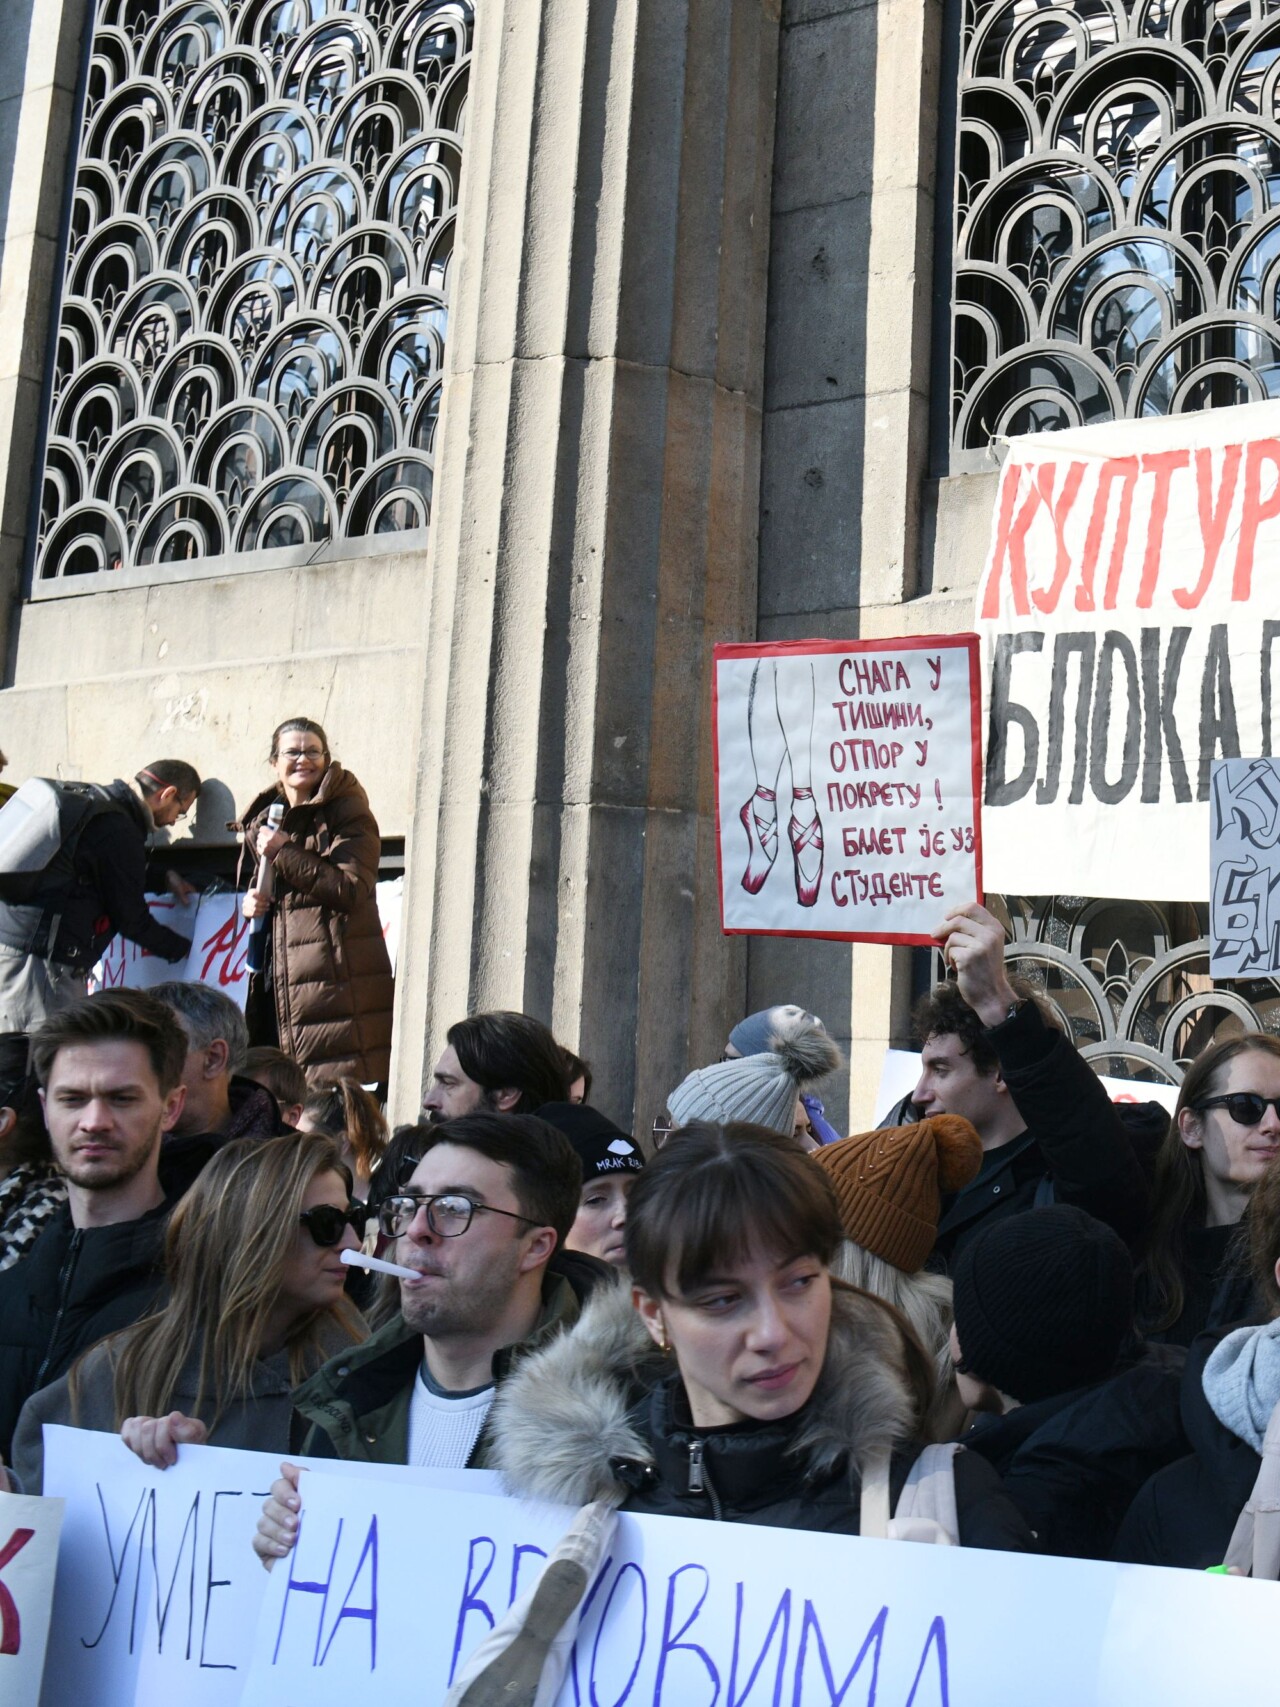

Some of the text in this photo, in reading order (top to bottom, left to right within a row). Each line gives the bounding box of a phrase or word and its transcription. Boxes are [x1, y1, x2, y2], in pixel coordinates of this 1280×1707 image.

[839, 655, 942, 696] СНАГА У
[832, 700, 934, 732] ТИШИНИ,
[829, 739, 928, 772] ОТПОР У
[841, 826, 907, 857] БАЛЕТ
[950, 827, 975, 854] УЗ
[831, 869, 945, 907] СТУДЕНТЕ
[596, 1156, 626, 1171] MRAK
[272, 1510, 378, 1673] НА
